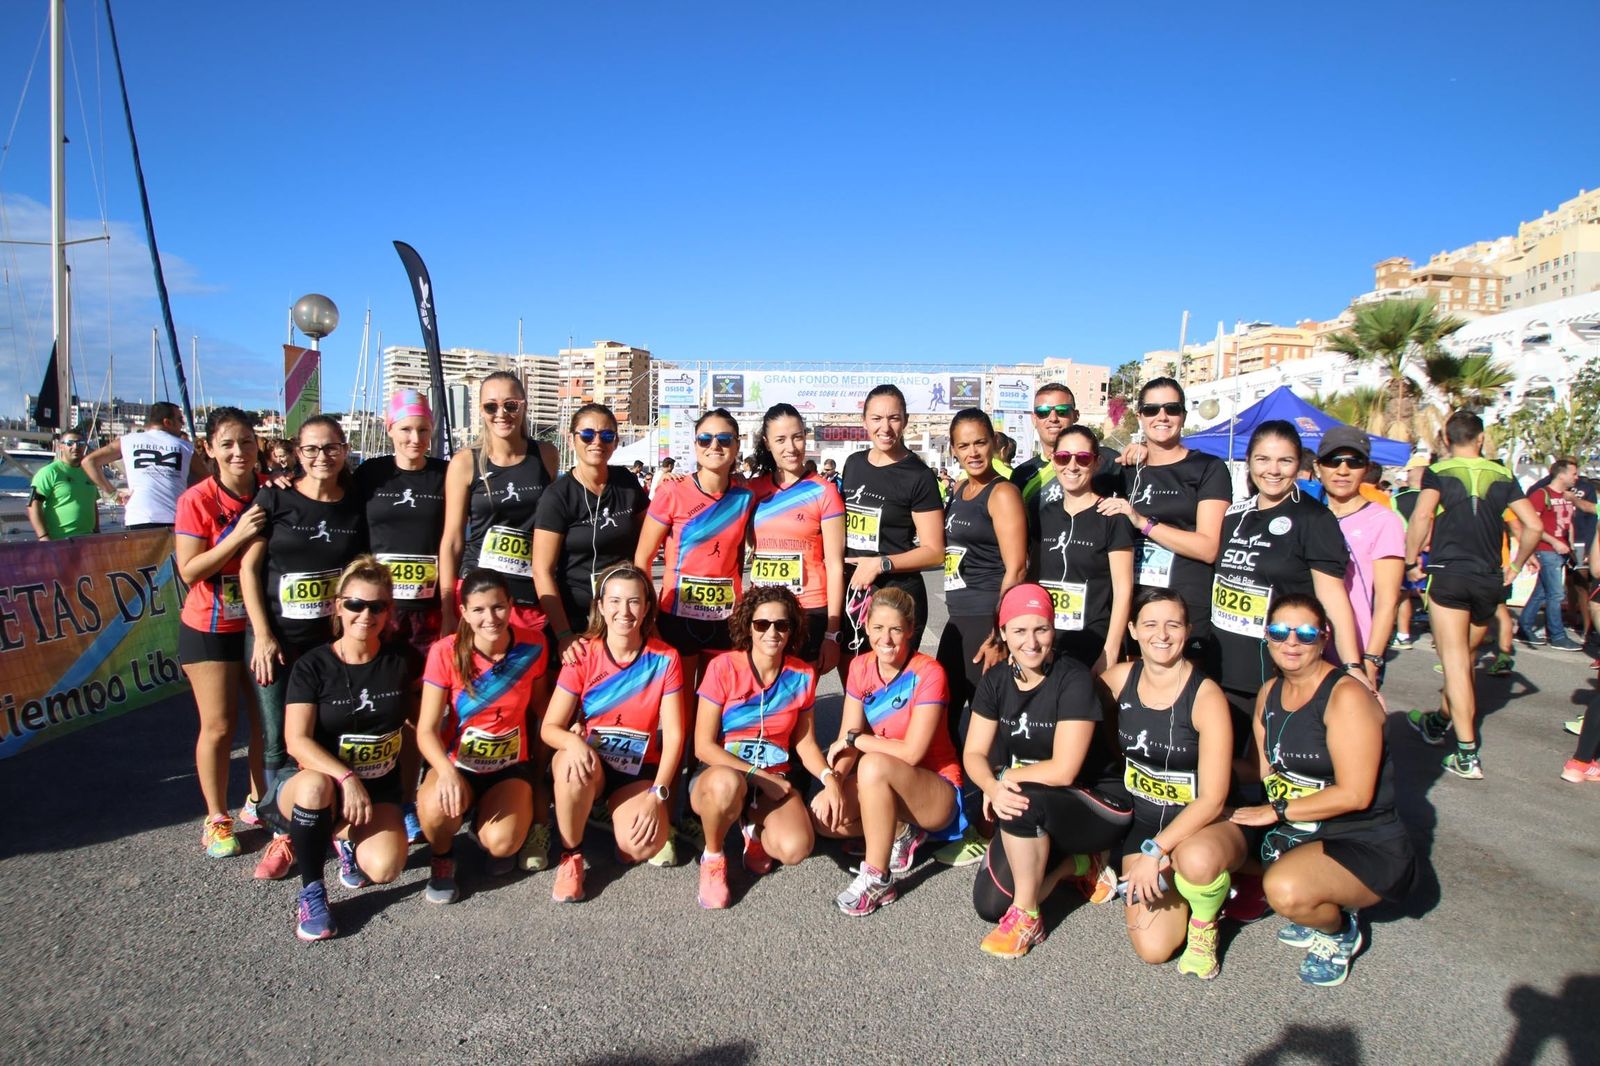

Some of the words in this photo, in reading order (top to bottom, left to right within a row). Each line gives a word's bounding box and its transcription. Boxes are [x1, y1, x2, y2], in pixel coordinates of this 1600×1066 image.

[764, 375, 796, 383] GRAN
[799, 375, 839, 384] FONDO
[133, 449, 182, 471] 24
[863, 491, 885, 500] FITNESS
[491, 537, 530, 556] 1803
[497, 556, 520, 565] asisa
[1221, 549, 1260, 567] SDC
[755, 562, 789, 577] 1578
[106, 566, 166, 623] DE
[286, 582, 330, 599] 1807
[684, 585, 725, 602] 1593
[1215, 587, 1252, 612] 1826
[1217, 610, 1238, 622] asisa
[345, 742, 392, 761] 1650
[467, 739, 510, 758] 1577
[598, 736, 632, 754] 274
[743, 744, 766, 760] 52
[1150, 741, 1187, 752] FITNESS
[1130, 772, 1178, 799] 1658
